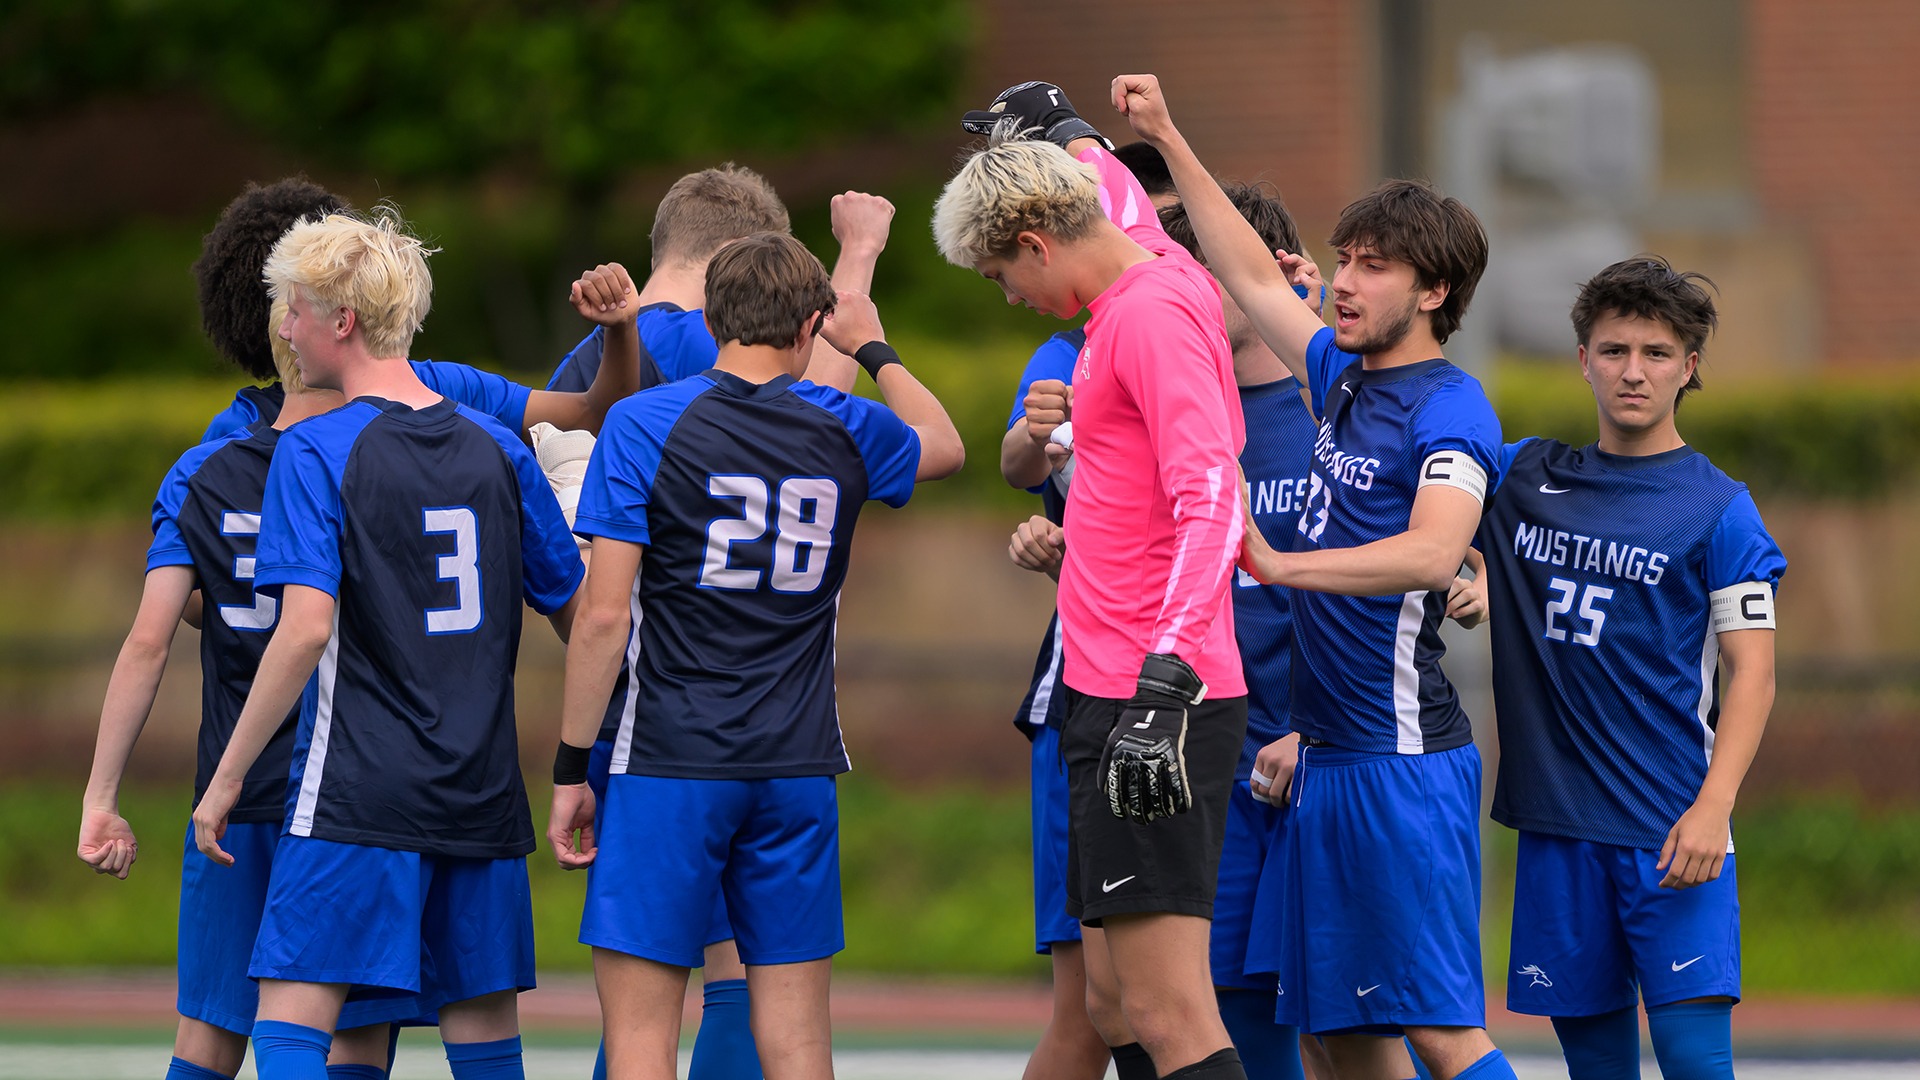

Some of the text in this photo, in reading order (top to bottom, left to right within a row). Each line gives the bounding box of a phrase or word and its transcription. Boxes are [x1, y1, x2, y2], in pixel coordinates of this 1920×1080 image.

[1425, 457, 1454, 480] C
[699, 475, 839, 593] 28
[1513, 521, 1670, 586] MUSTANGS
[424, 507, 482, 633] 3
[1545, 576, 1615, 647] 25
[1740, 593, 1767, 620] C
